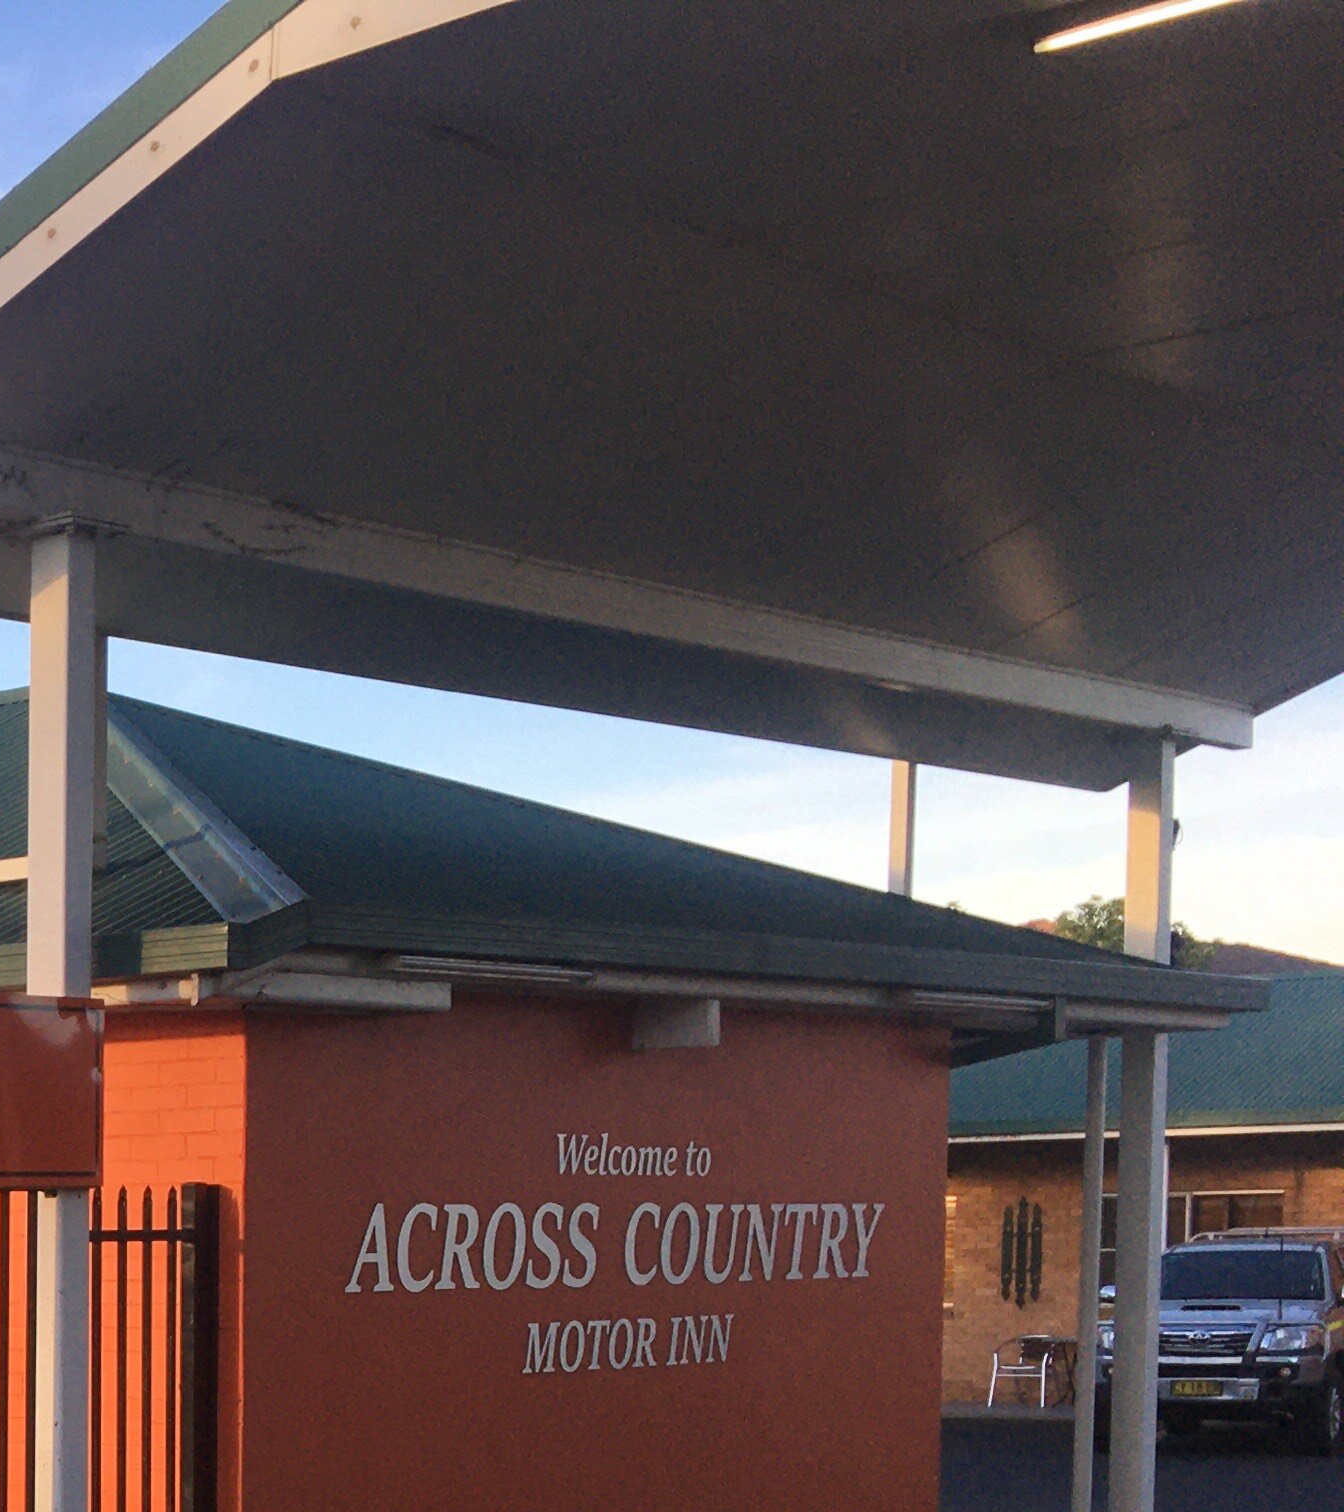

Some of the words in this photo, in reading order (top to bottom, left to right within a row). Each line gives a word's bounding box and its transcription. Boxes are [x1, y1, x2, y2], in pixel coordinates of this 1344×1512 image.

[556, 1132, 678, 1177] Welcome
[686, 1140, 712, 1177] to
[345, 1201, 600, 1293] ACROSS
[624, 1201, 886, 1286] COUNTRY
[522, 1317, 657, 1375] MOTOR
[665, 1313, 735, 1367] INN
